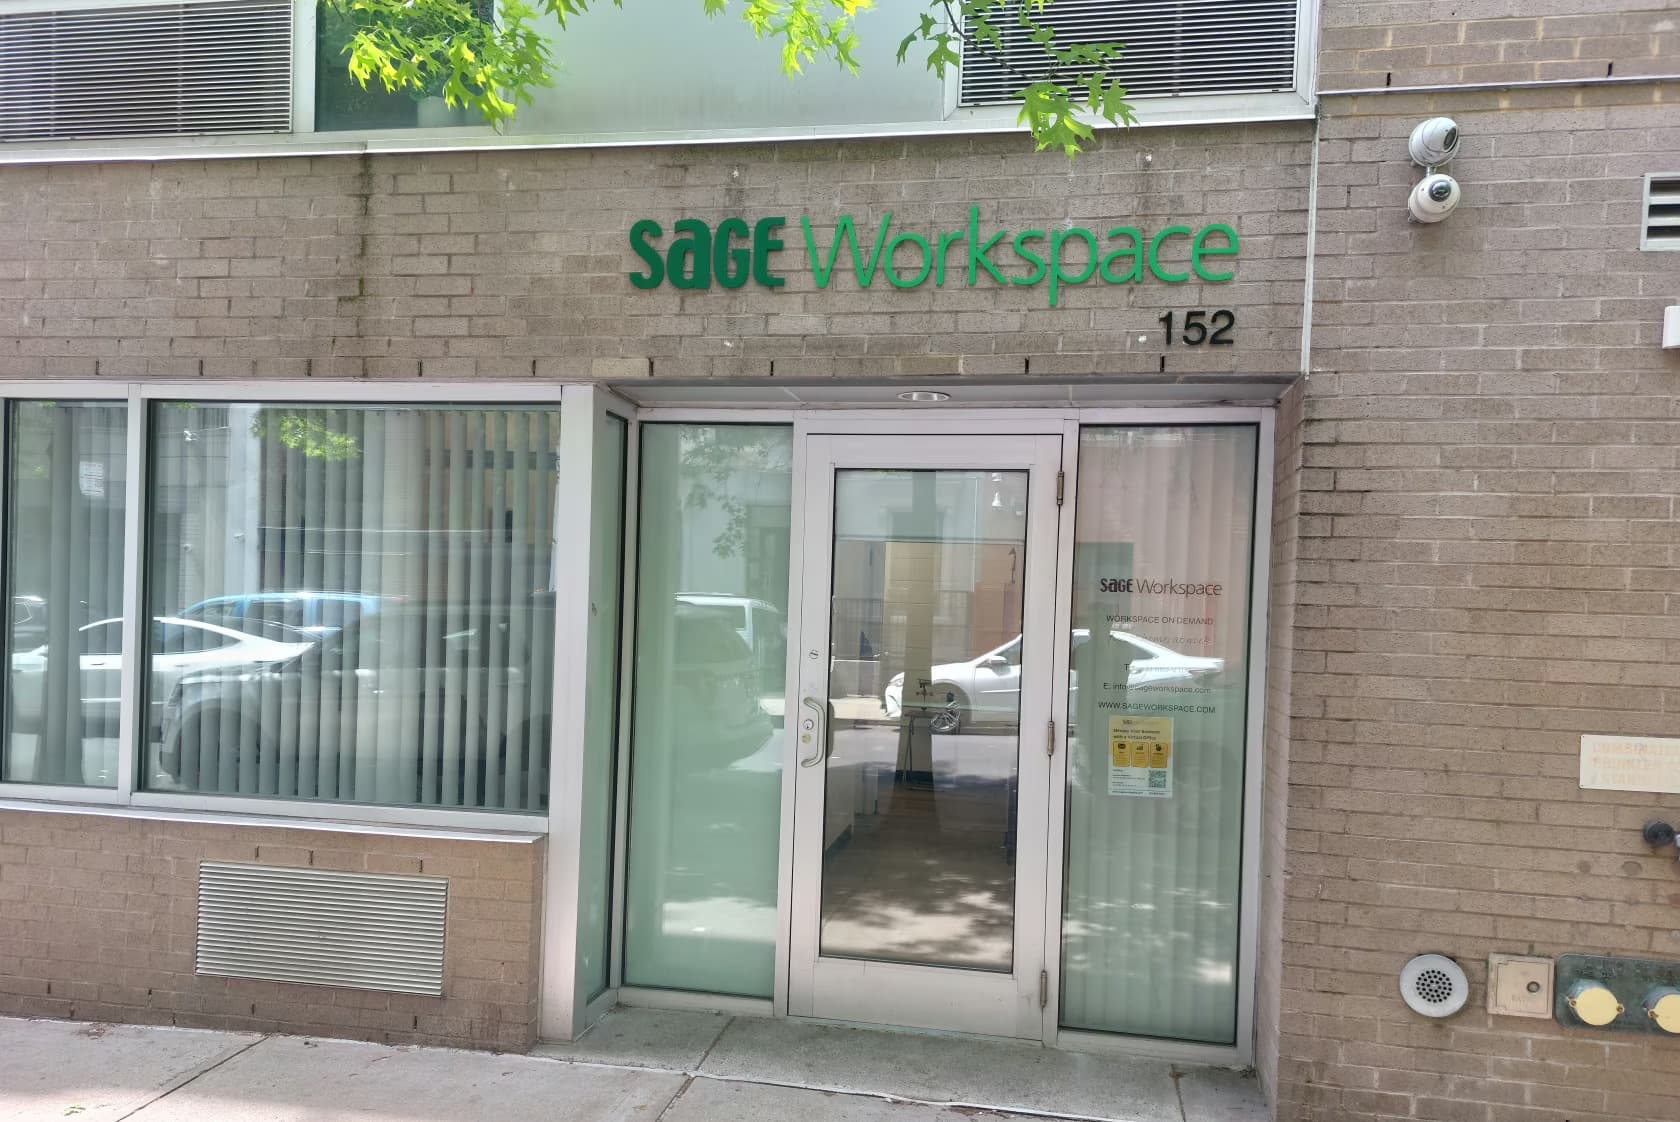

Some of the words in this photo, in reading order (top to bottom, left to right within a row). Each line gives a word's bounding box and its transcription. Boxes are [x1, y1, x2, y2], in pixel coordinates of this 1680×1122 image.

[801, 205, 1240, 306] Workspace
[1159, 309, 1235, 346] 152
[1136, 578, 1223, 598] Workspace
[1106, 615, 1159, 624] WORKSPACE
[1161, 616, 1175, 624] ON
[1176, 617, 1214, 625] DEMAND
[1098, 702, 1216, 713] WWW.SAGEWORKSPACE.COM
